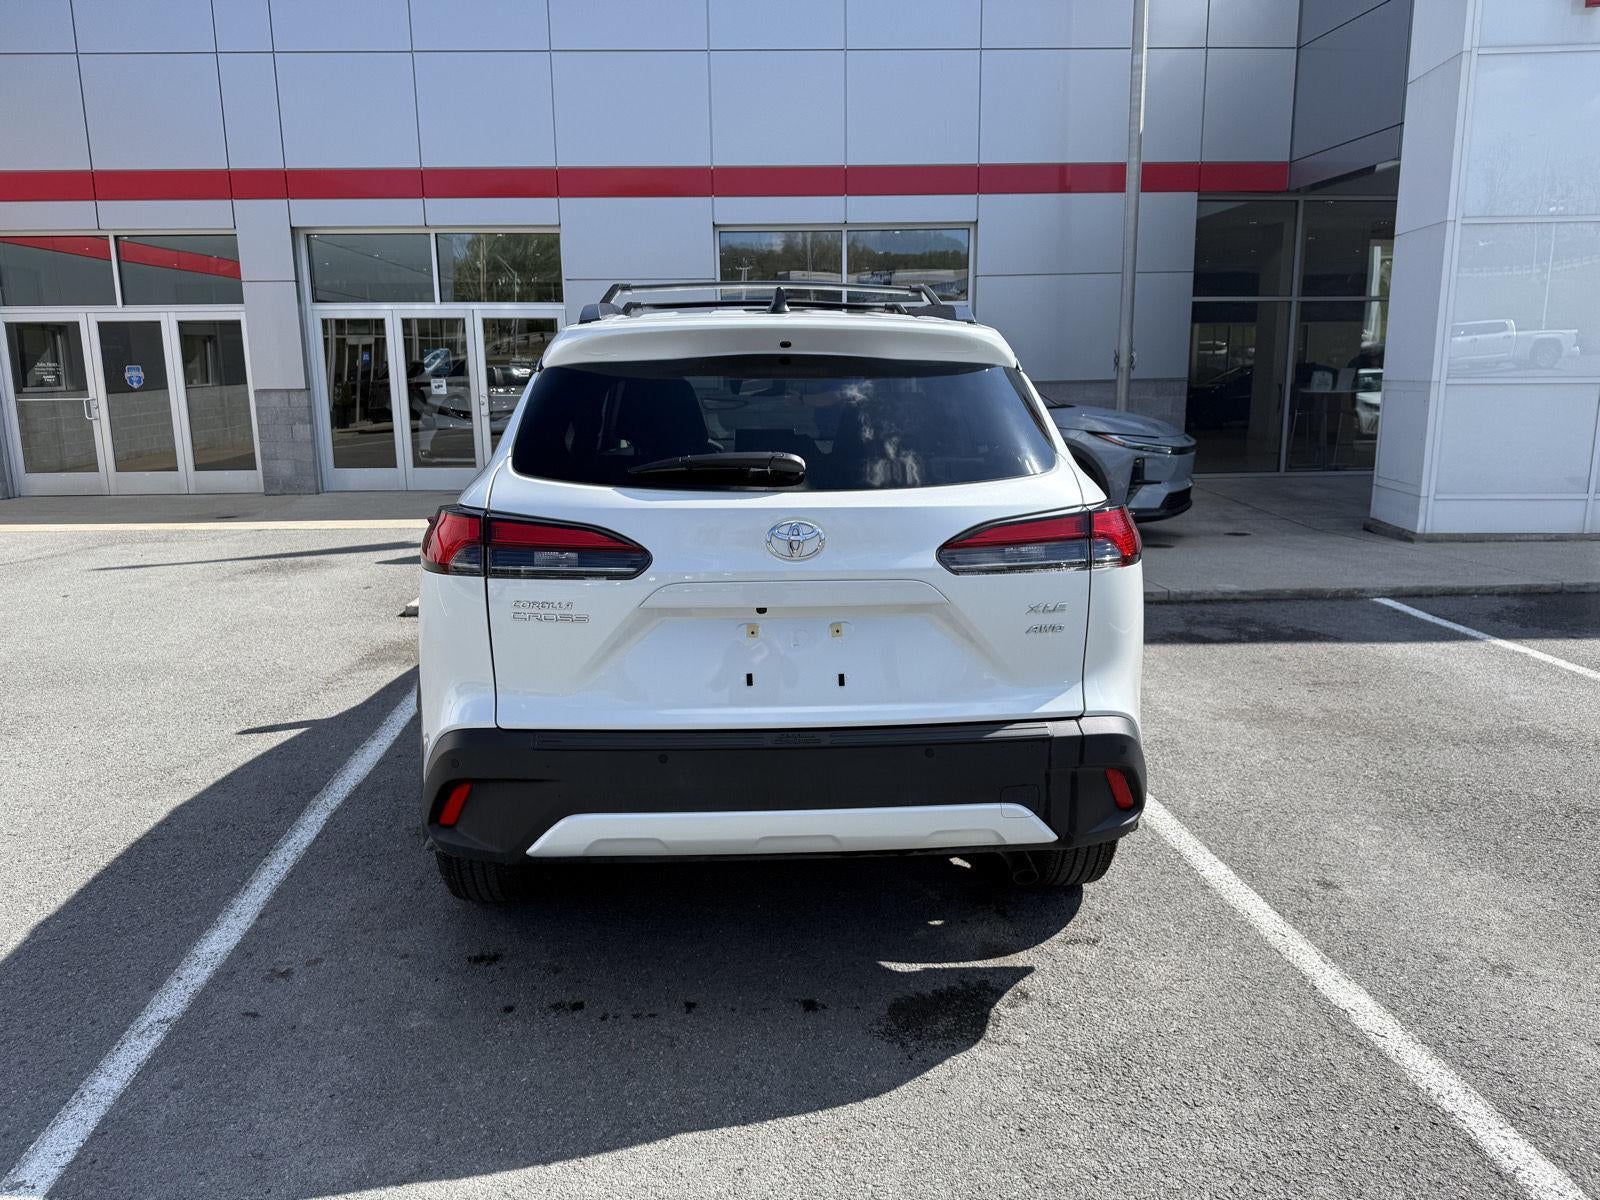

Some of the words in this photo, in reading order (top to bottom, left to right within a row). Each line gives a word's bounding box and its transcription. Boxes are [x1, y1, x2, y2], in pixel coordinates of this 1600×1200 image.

[512, 600, 573, 609] COROLLA
[1025, 602, 1068, 614] XLE
[512, 612, 589, 622] CROSS
[1025, 624, 1064, 634] AWD
